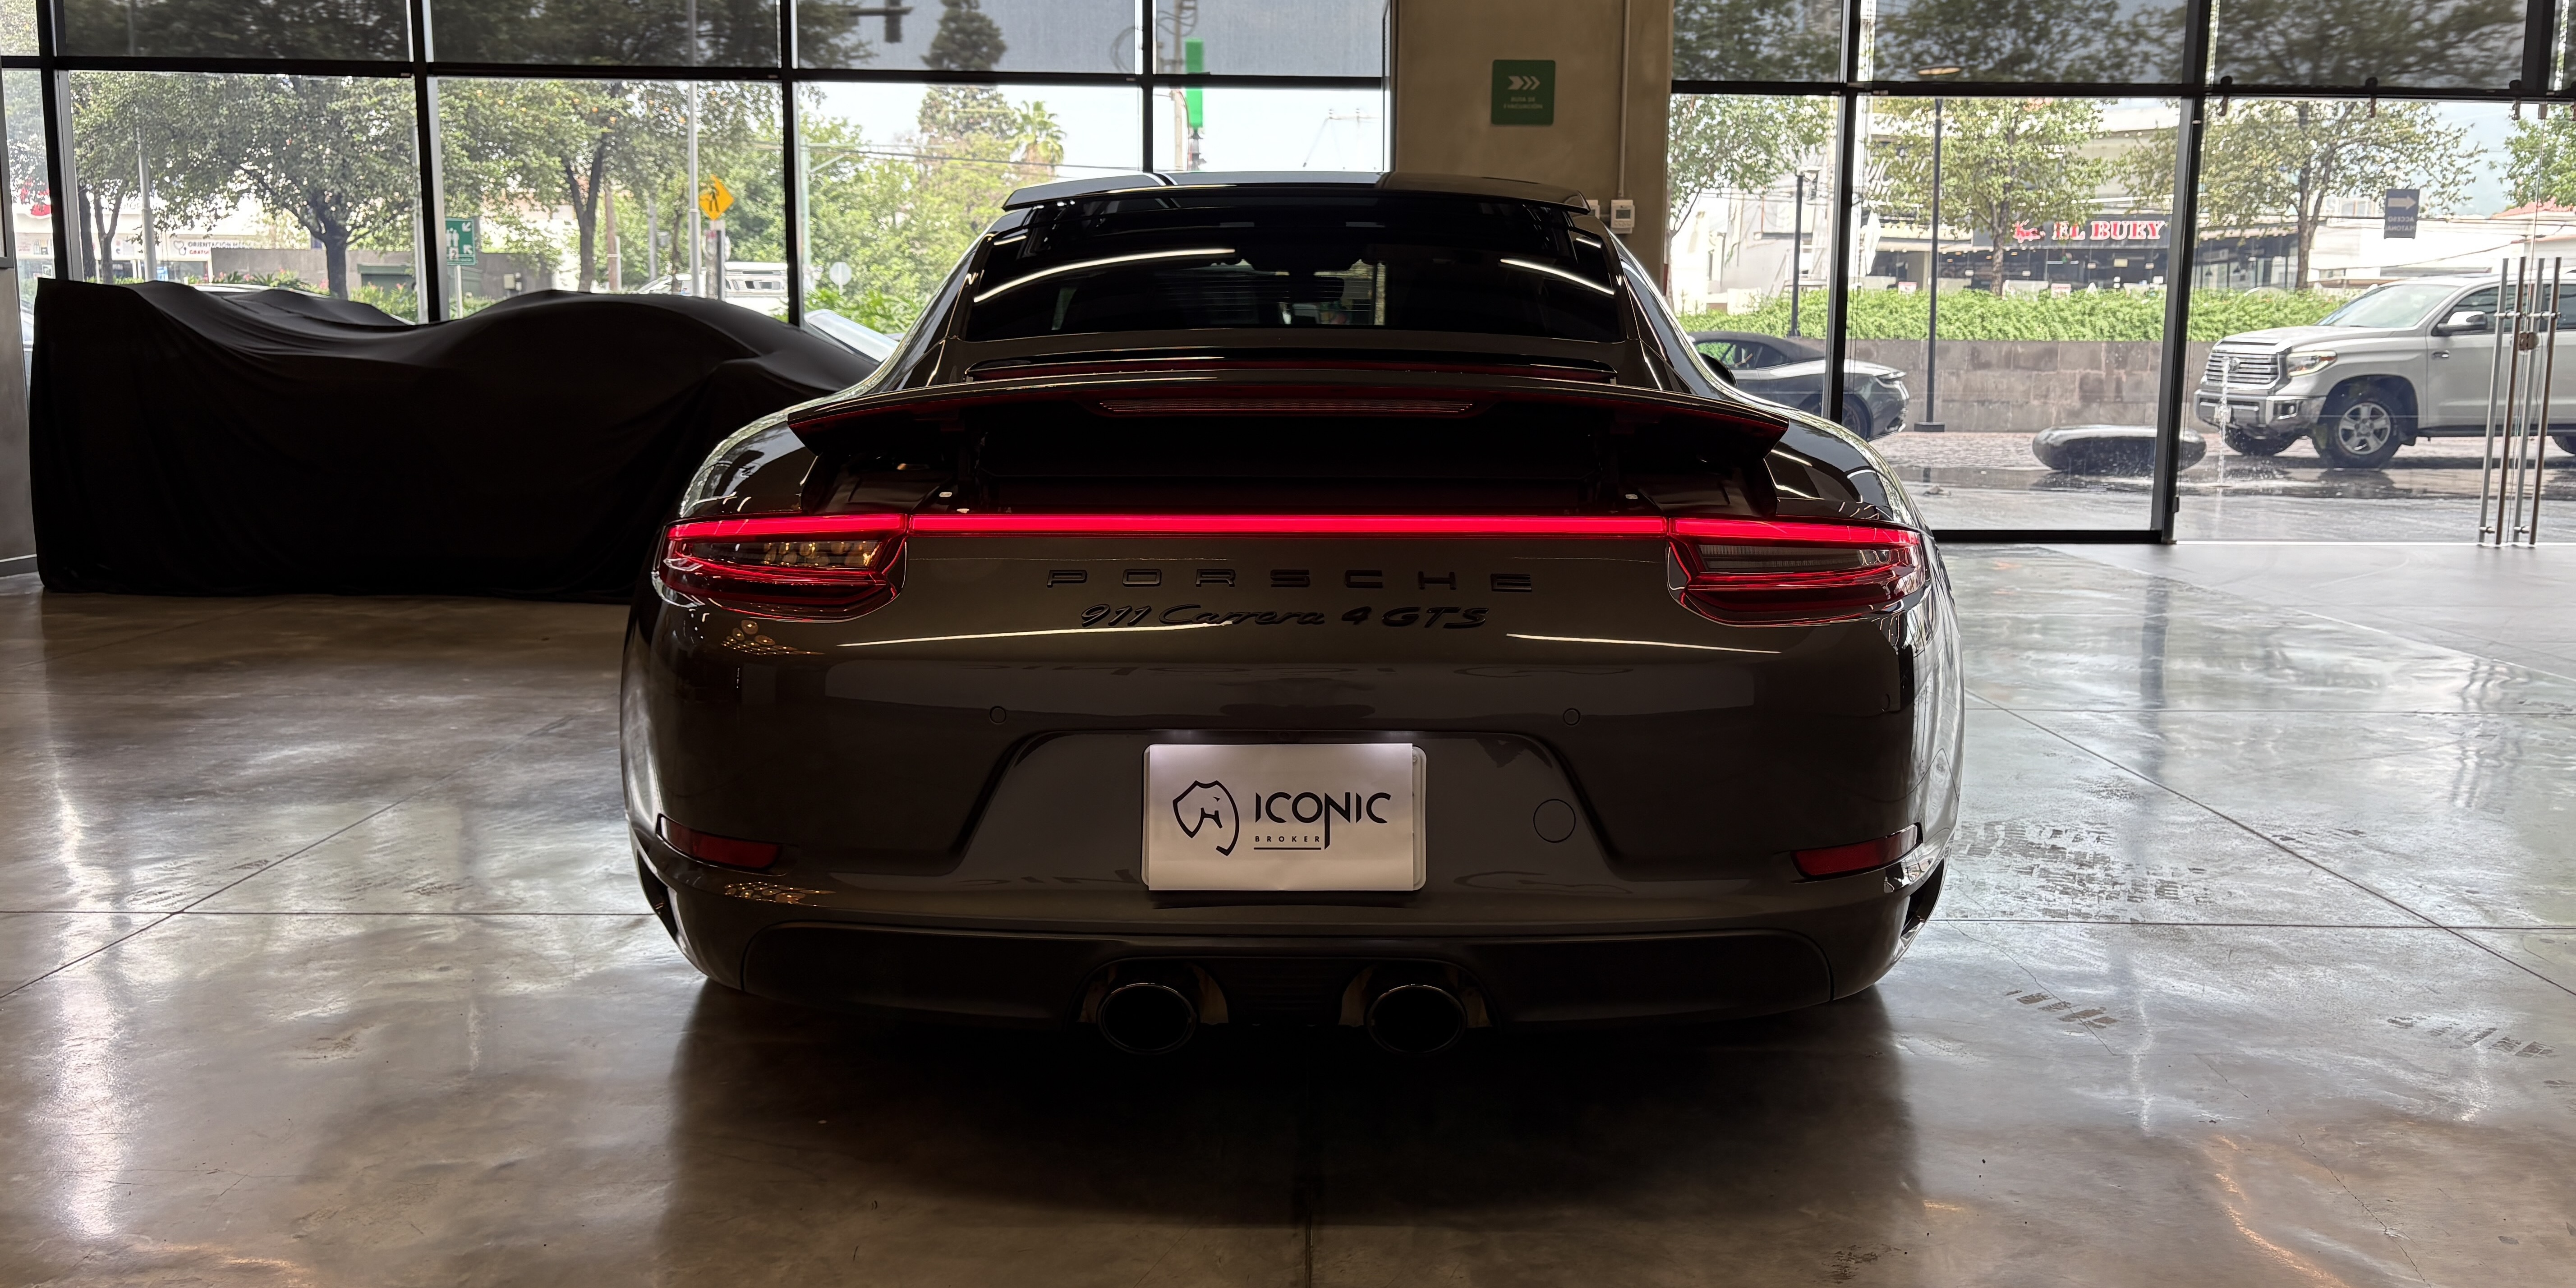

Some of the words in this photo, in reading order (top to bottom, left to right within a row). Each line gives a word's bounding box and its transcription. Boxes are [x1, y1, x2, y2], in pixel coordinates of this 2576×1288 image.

[2052, 221, 2085, 239] EL
[2090, 221, 2165, 239] BUEY
[1047, 569, 1532, 592] PORSCHE
[1081, 604, 1152, 627] 911
[1159, 604, 1325, 625] Carrera
[1341, 606, 1372, 625] 4
[1381, 606, 1489, 629] GTS
[1256, 792, 1391, 850] ICONIC
